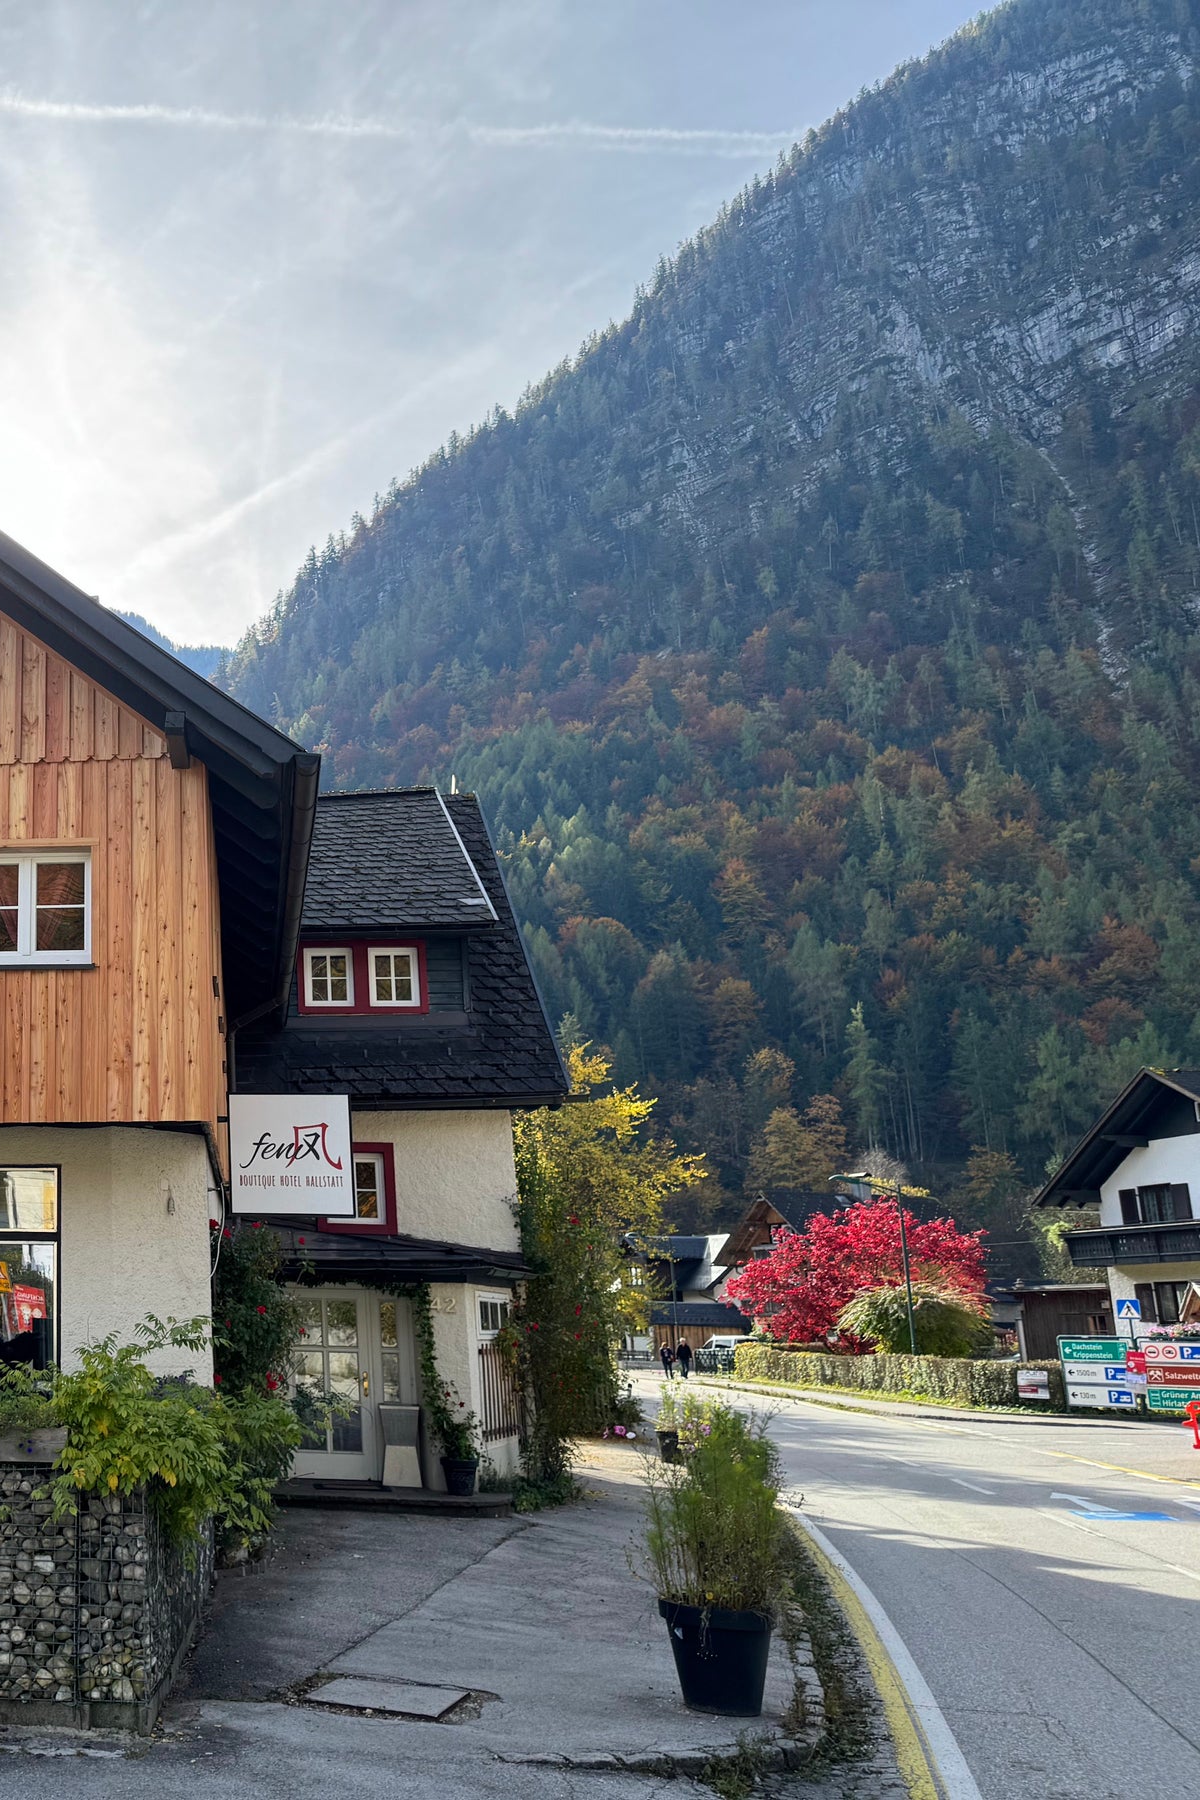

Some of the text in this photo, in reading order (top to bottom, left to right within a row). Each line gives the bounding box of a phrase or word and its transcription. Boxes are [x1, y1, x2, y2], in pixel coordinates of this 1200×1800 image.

[239, 1174, 344, 1189] BOUTIQUE HOTEL HALLSTATT
[1072, 1351, 1113, 1359] Krippenstein
[1161, 1391, 1189, 1399] Grüner
